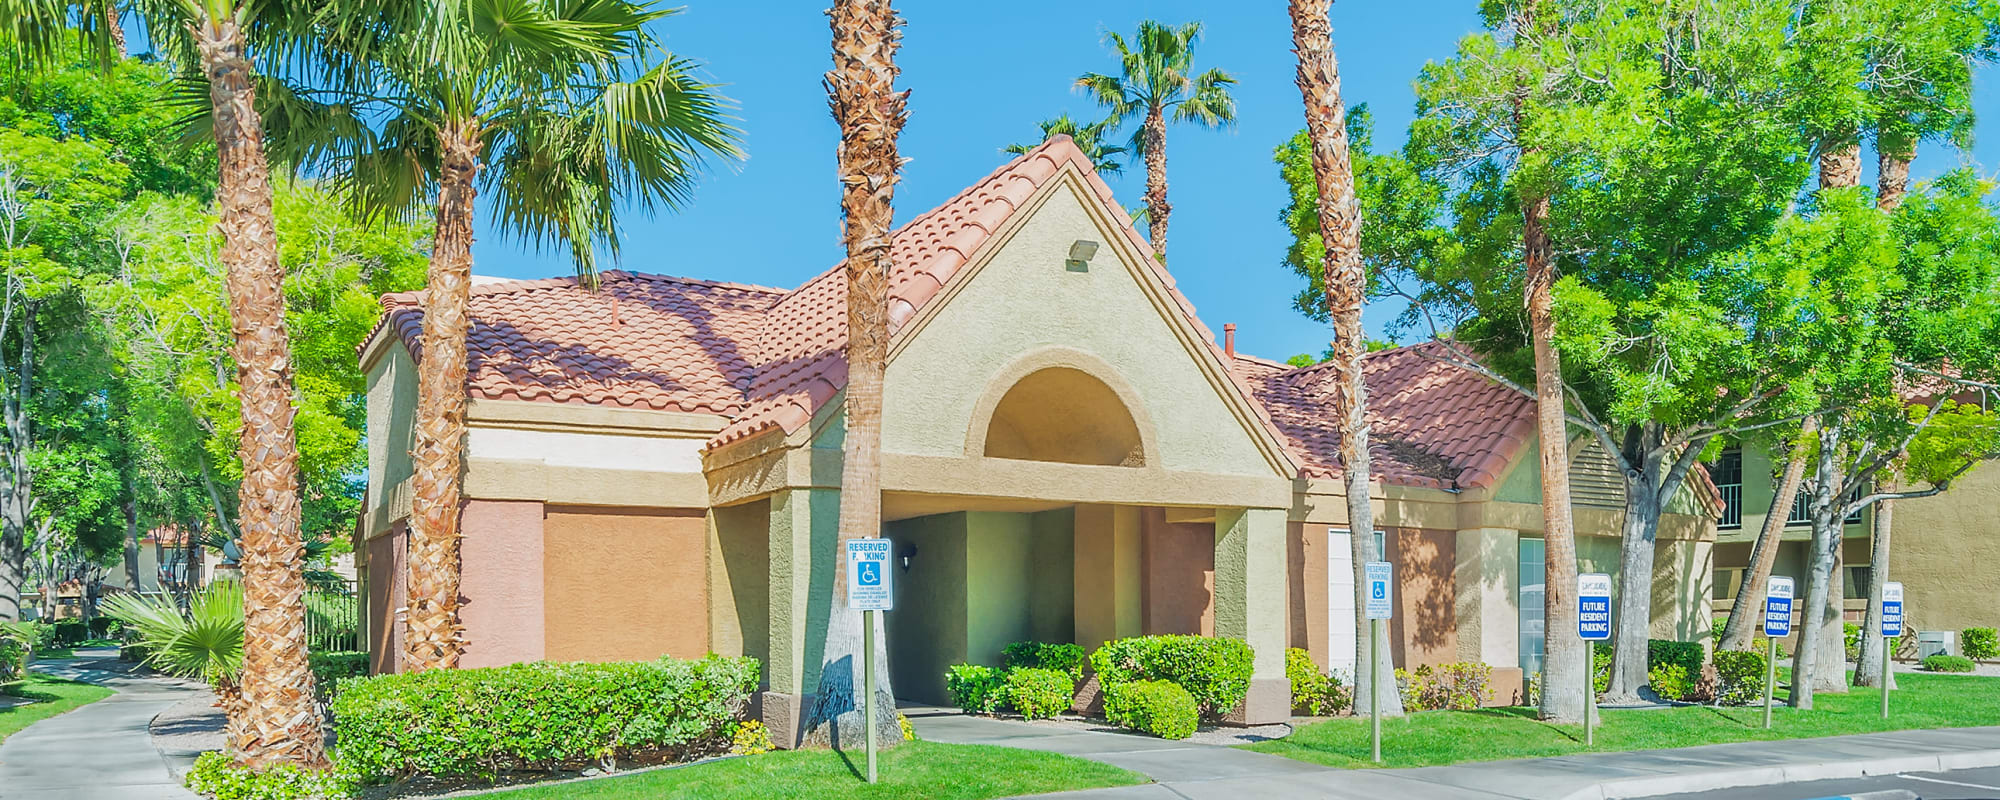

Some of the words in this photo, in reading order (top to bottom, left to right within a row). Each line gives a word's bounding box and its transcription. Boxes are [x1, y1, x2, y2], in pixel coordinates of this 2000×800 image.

[849, 543, 888, 551] RESERVED
[852, 552, 886, 560] PKING
[1582, 602, 1606, 611] FUTURE
[1770, 602, 1789, 611] FUTURE
[1580, 612, 1608, 621] RESIDENT
[1767, 612, 1789, 621] RESIDENT
[1581, 623, 1607, 631] PARKING
[1767, 621, 1788, 630] PARKING
